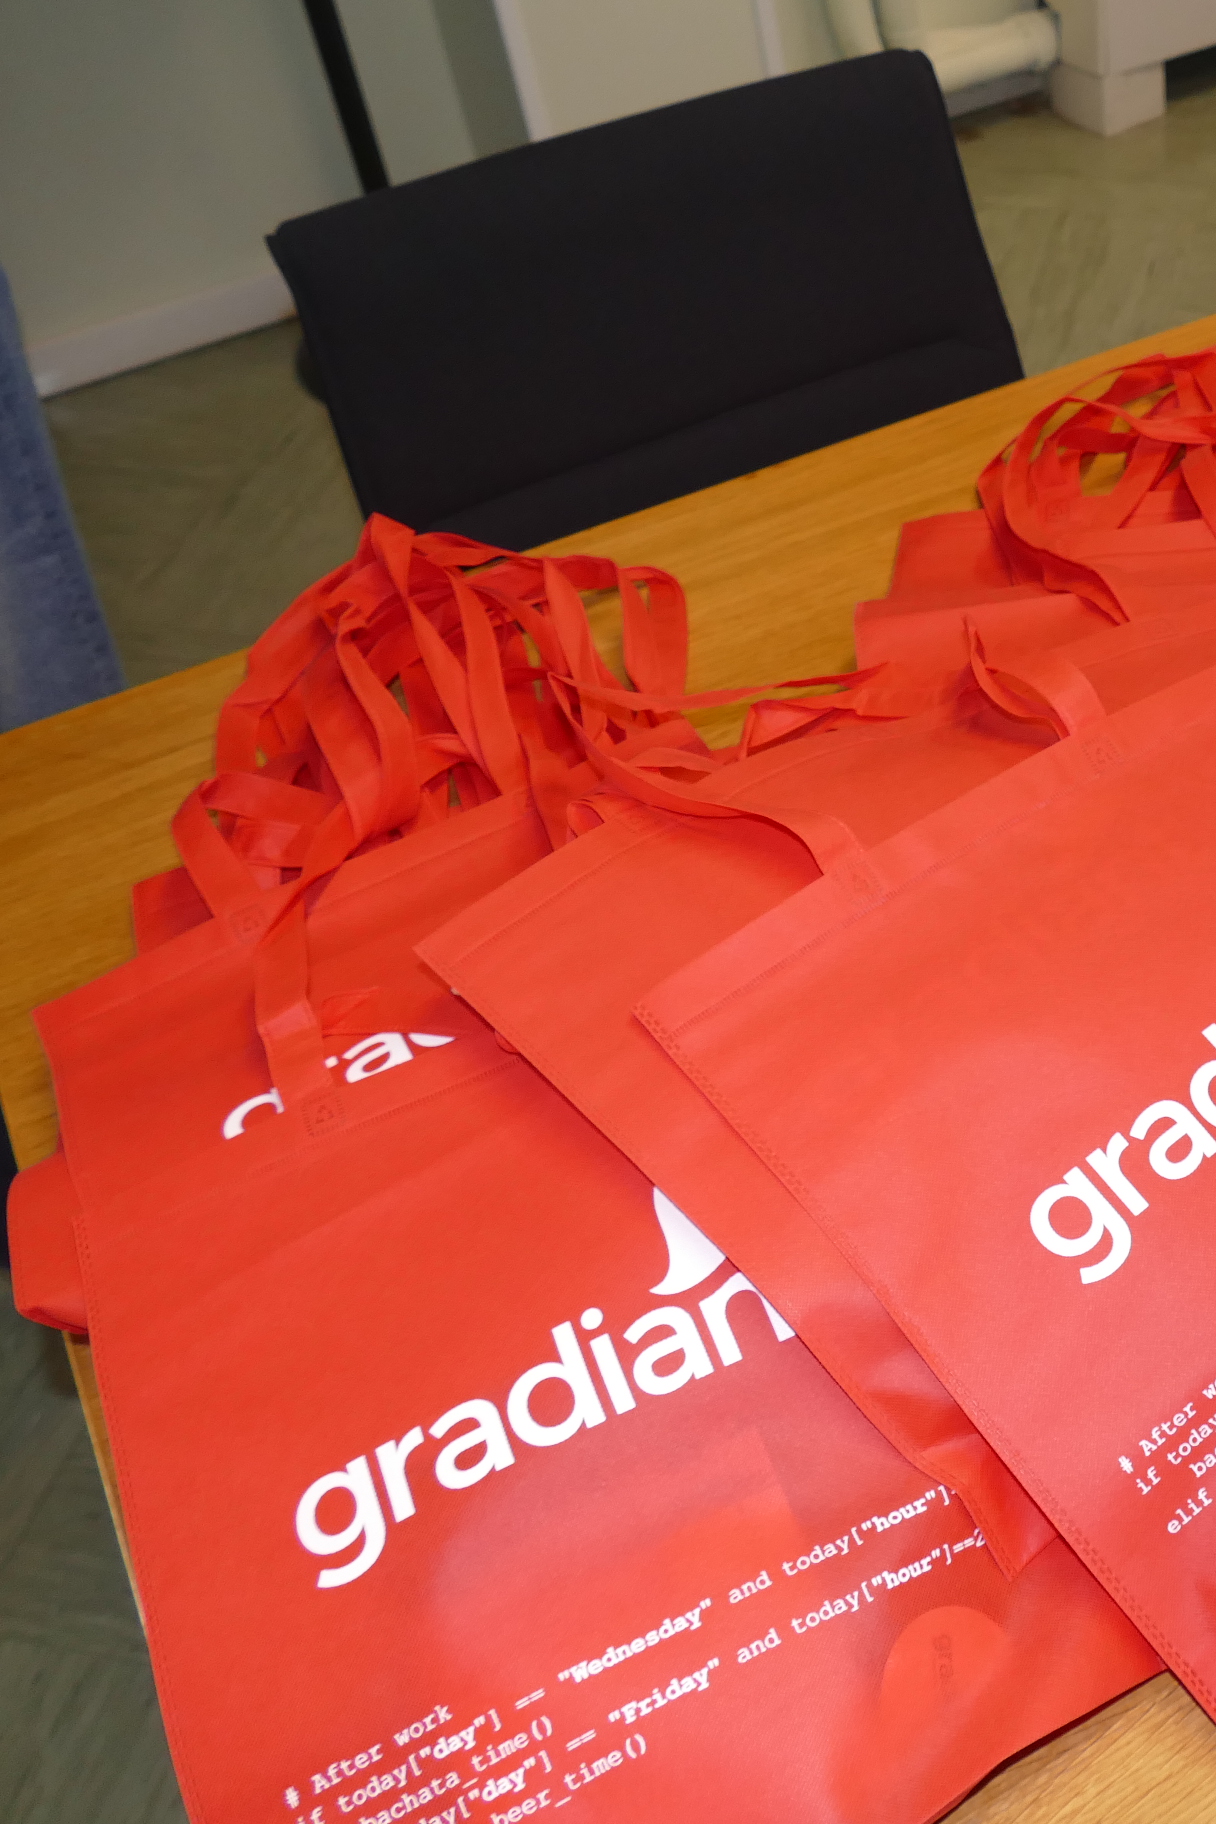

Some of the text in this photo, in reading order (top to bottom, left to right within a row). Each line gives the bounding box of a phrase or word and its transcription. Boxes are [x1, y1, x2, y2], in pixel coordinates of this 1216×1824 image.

[295, 1271, 795, 1590] gradian
[1118, 1454, 1134, 1474] #
[1139, 1401, 1197, 1457] After
[1136, 1466, 1161, 1495] if
[1167, 1487, 1213, 1534] elif
[337, 1708, 502, 1813] today["day"]
[515, 1688, 546, 1710] ==
[558, 1597, 712, 1685] "Wednesday"
[728, 1571, 773, 1605] and
[782, 1484, 957, 1577] today["hour"]
[566, 1728, 597, 1752] ==
[608, 1658, 720, 1725] "Friday"
[736, 1628, 782, 1666] and
[790, 1529, 985, 1635] today["hour"]==2
[285, 1704, 453, 1810] # After work
[490, 1733, 648, 1824] beer_time()
